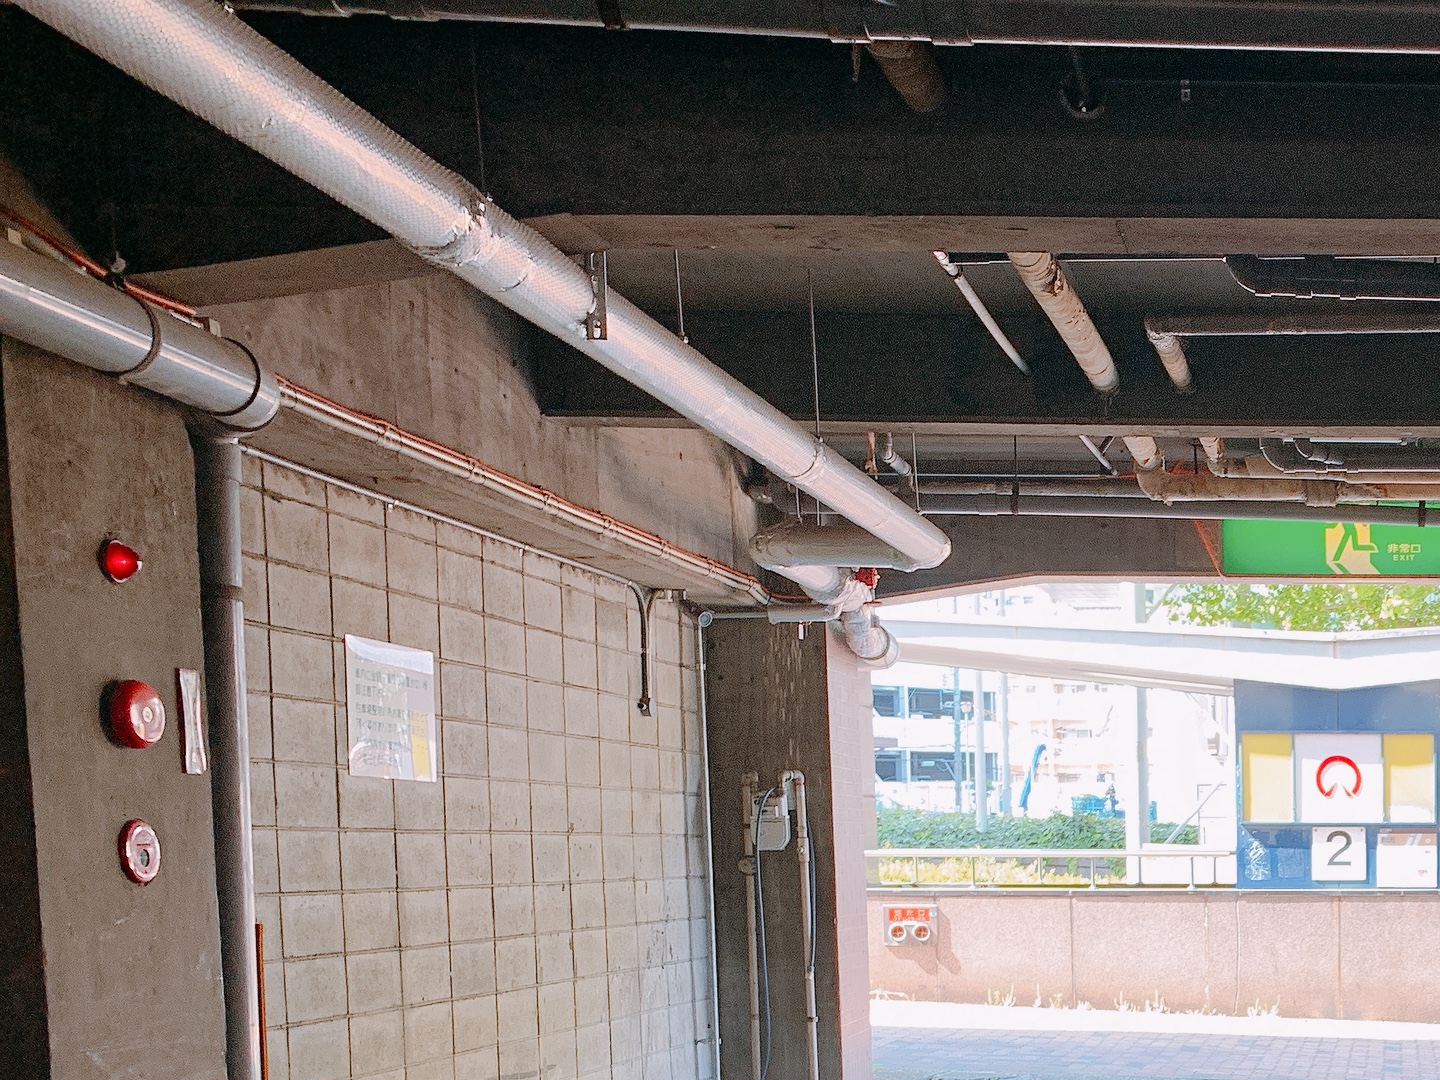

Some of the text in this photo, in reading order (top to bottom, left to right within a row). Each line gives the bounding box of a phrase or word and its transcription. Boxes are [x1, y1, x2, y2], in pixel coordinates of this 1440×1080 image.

[1387, 543, 1421, 553] 非常口
[1326, 830, 1352, 866] 2
